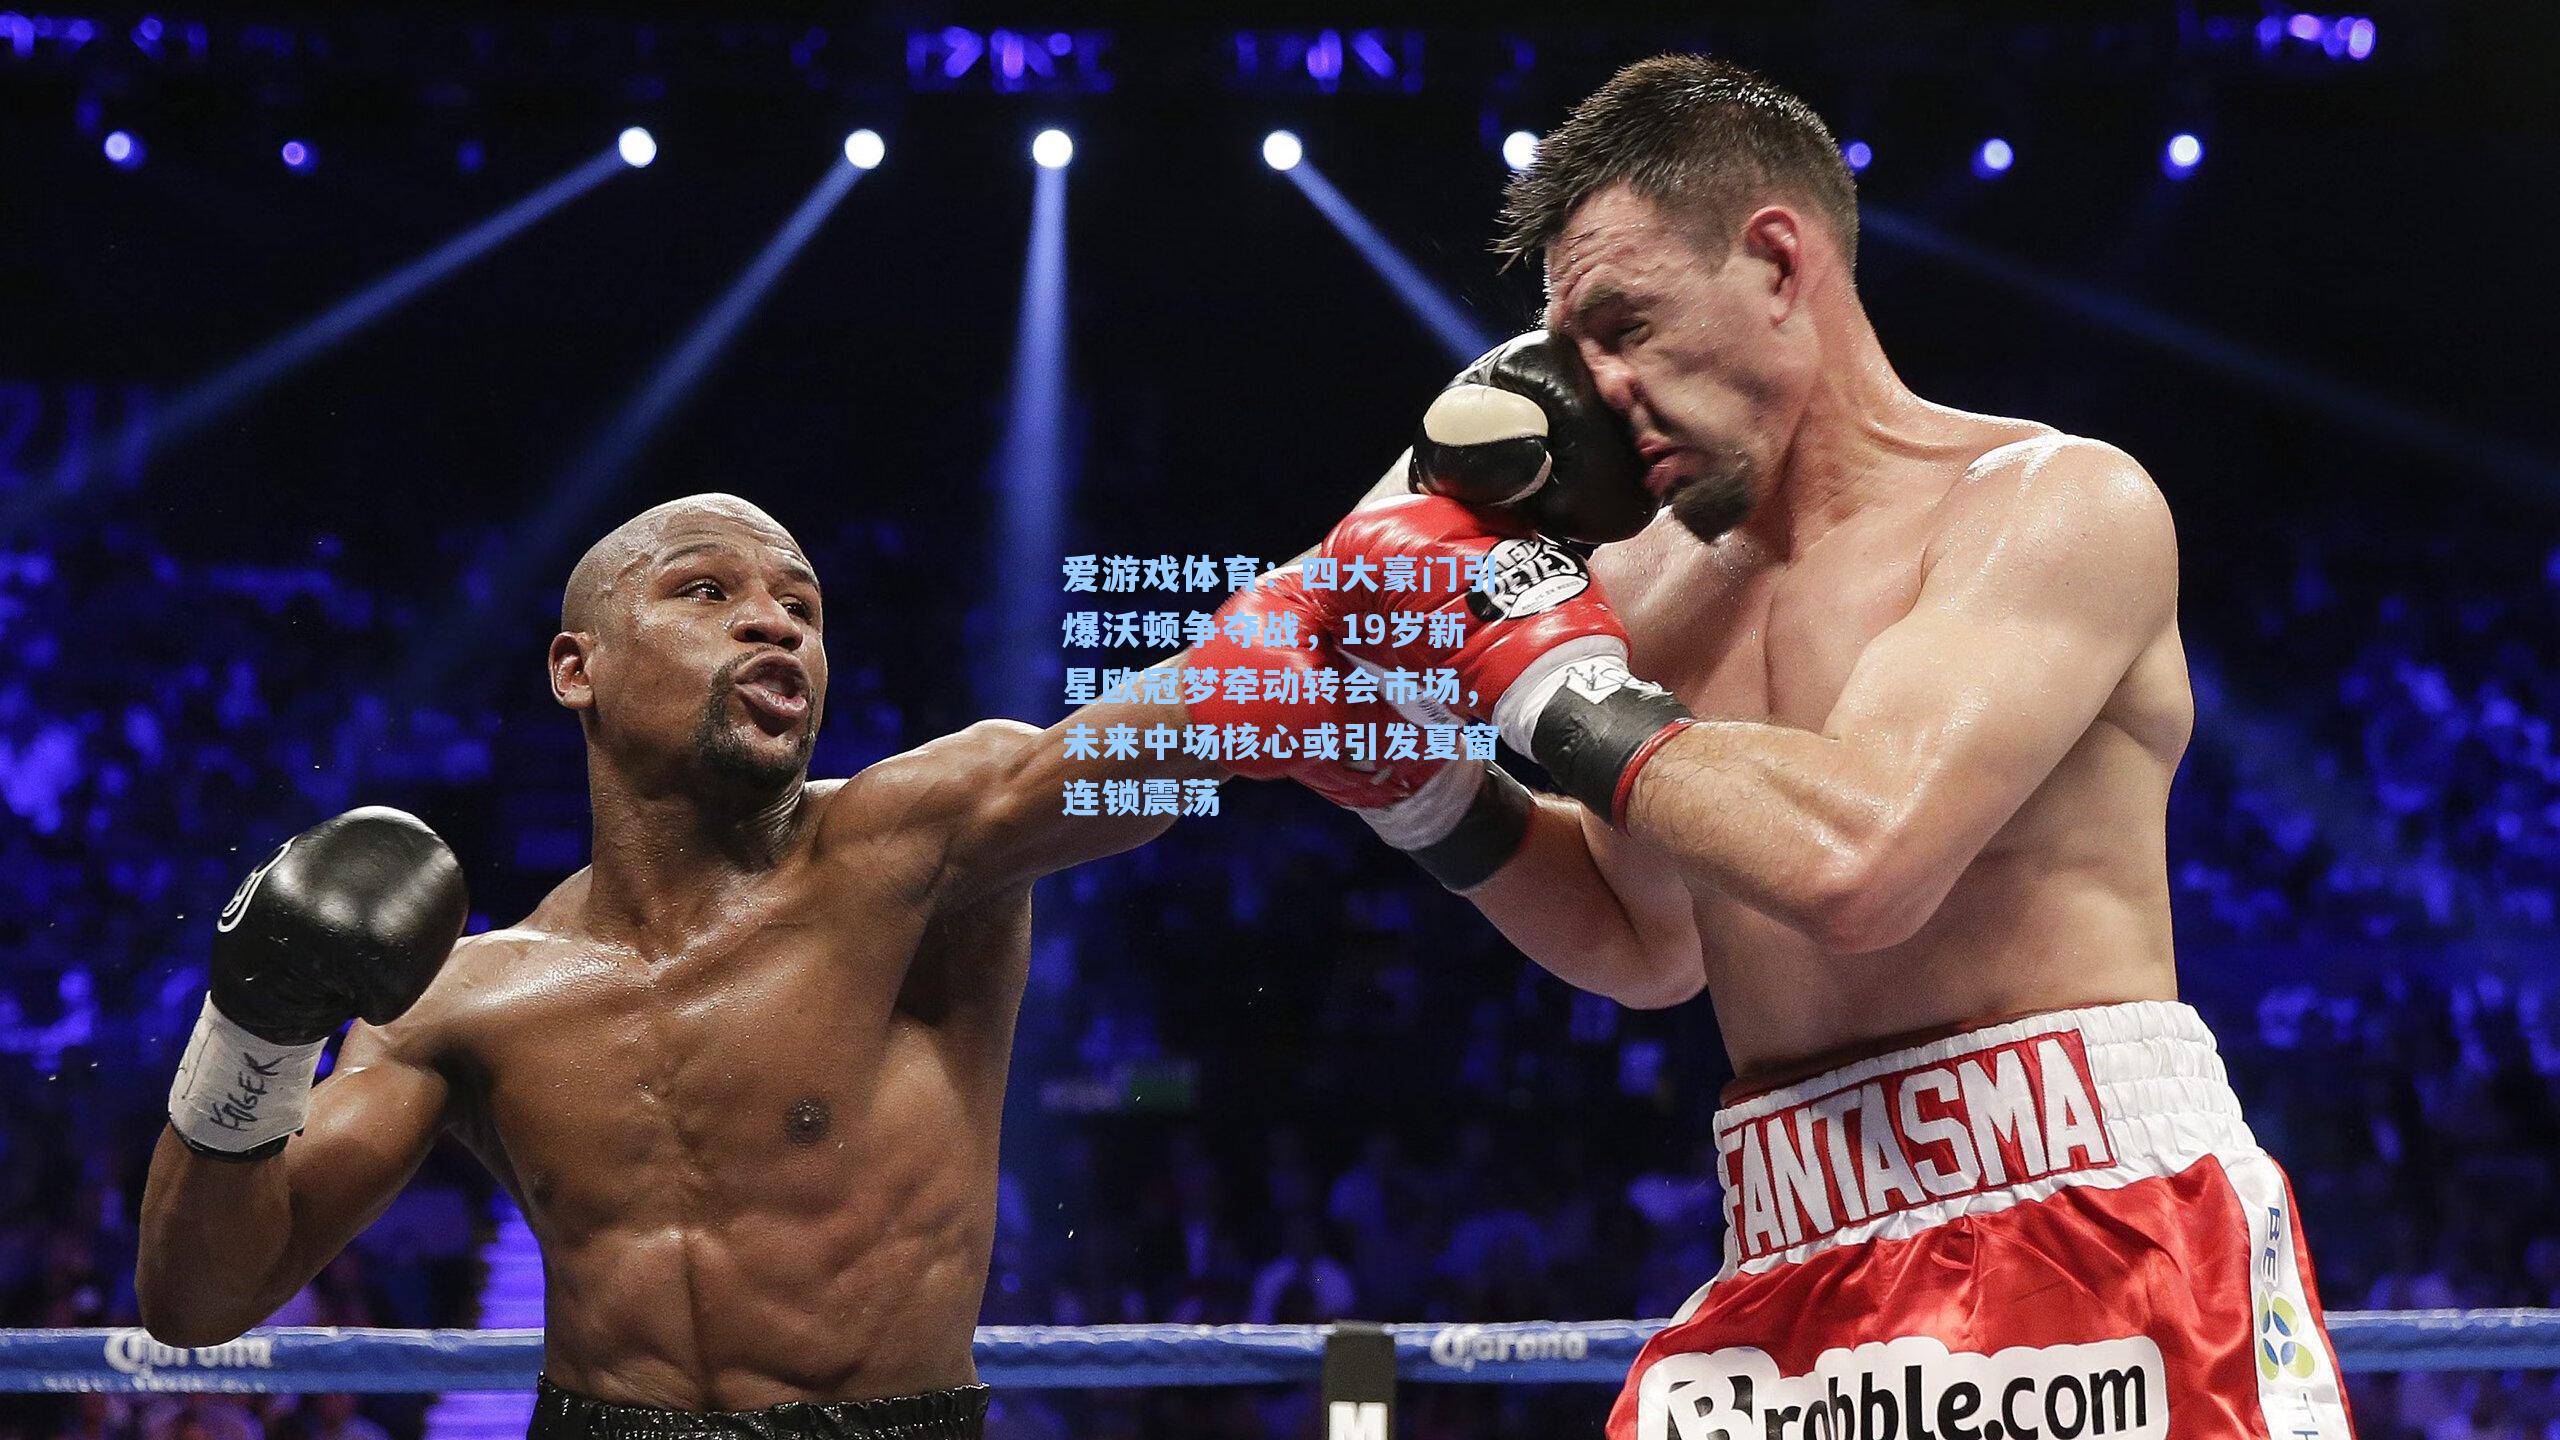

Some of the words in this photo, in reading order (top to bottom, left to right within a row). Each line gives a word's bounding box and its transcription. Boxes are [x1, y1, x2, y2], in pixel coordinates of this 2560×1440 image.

[1480, 543, 1580, 614] REYES
[1720, 1038, 2111, 1257] FANTASMA
[1430, 1324, 1588, 1372] Corona
